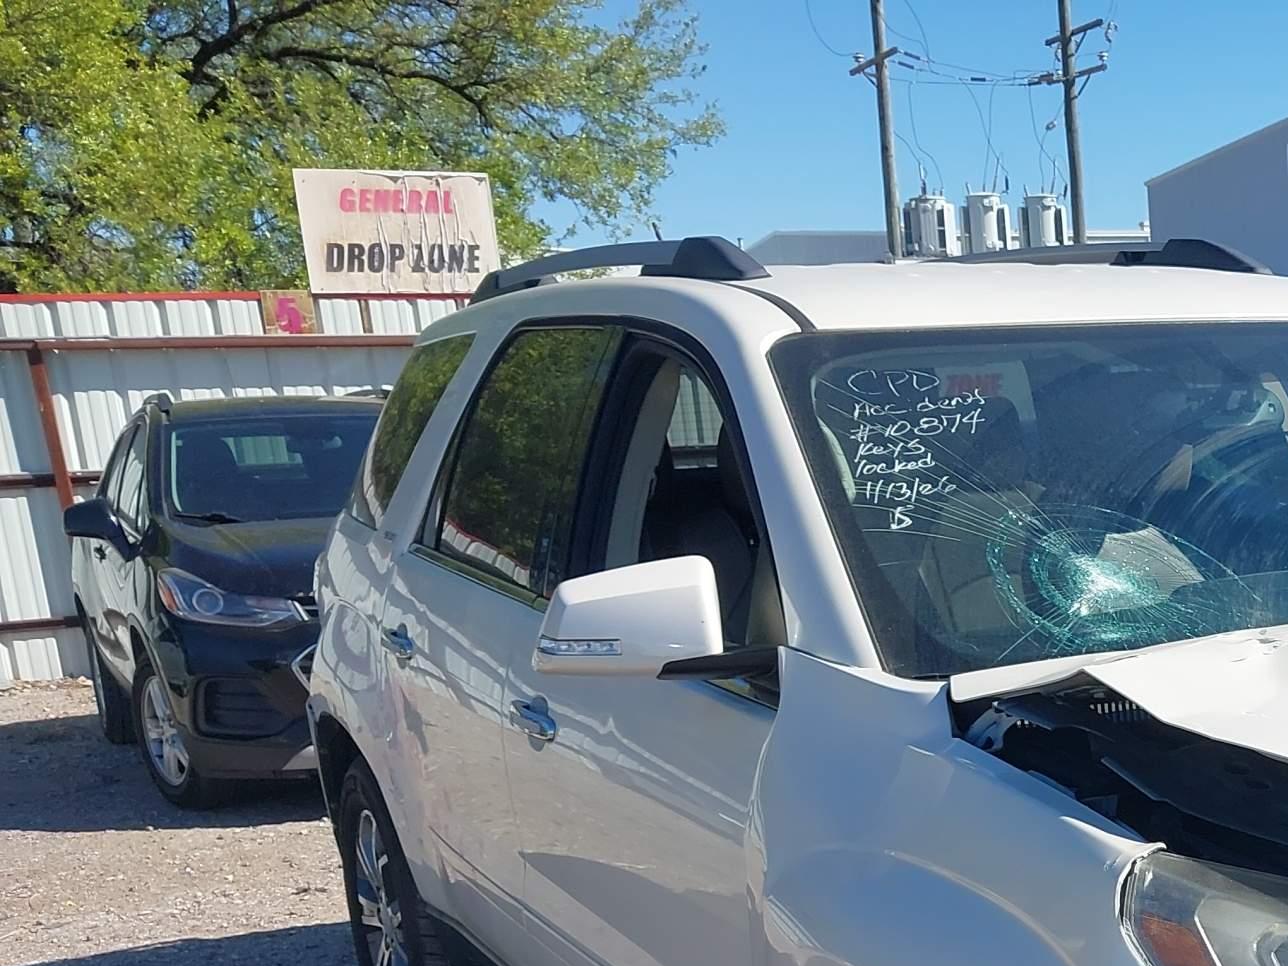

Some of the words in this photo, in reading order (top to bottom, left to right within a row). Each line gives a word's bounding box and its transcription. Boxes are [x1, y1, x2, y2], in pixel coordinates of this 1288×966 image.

[339, 188, 453, 215] GENERAL
[326, 242, 405, 273] DROP
[411, 242, 481, 274] ZONE
[275, 297, 305, 334] 5
[847, 369, 940, 397] CPD
